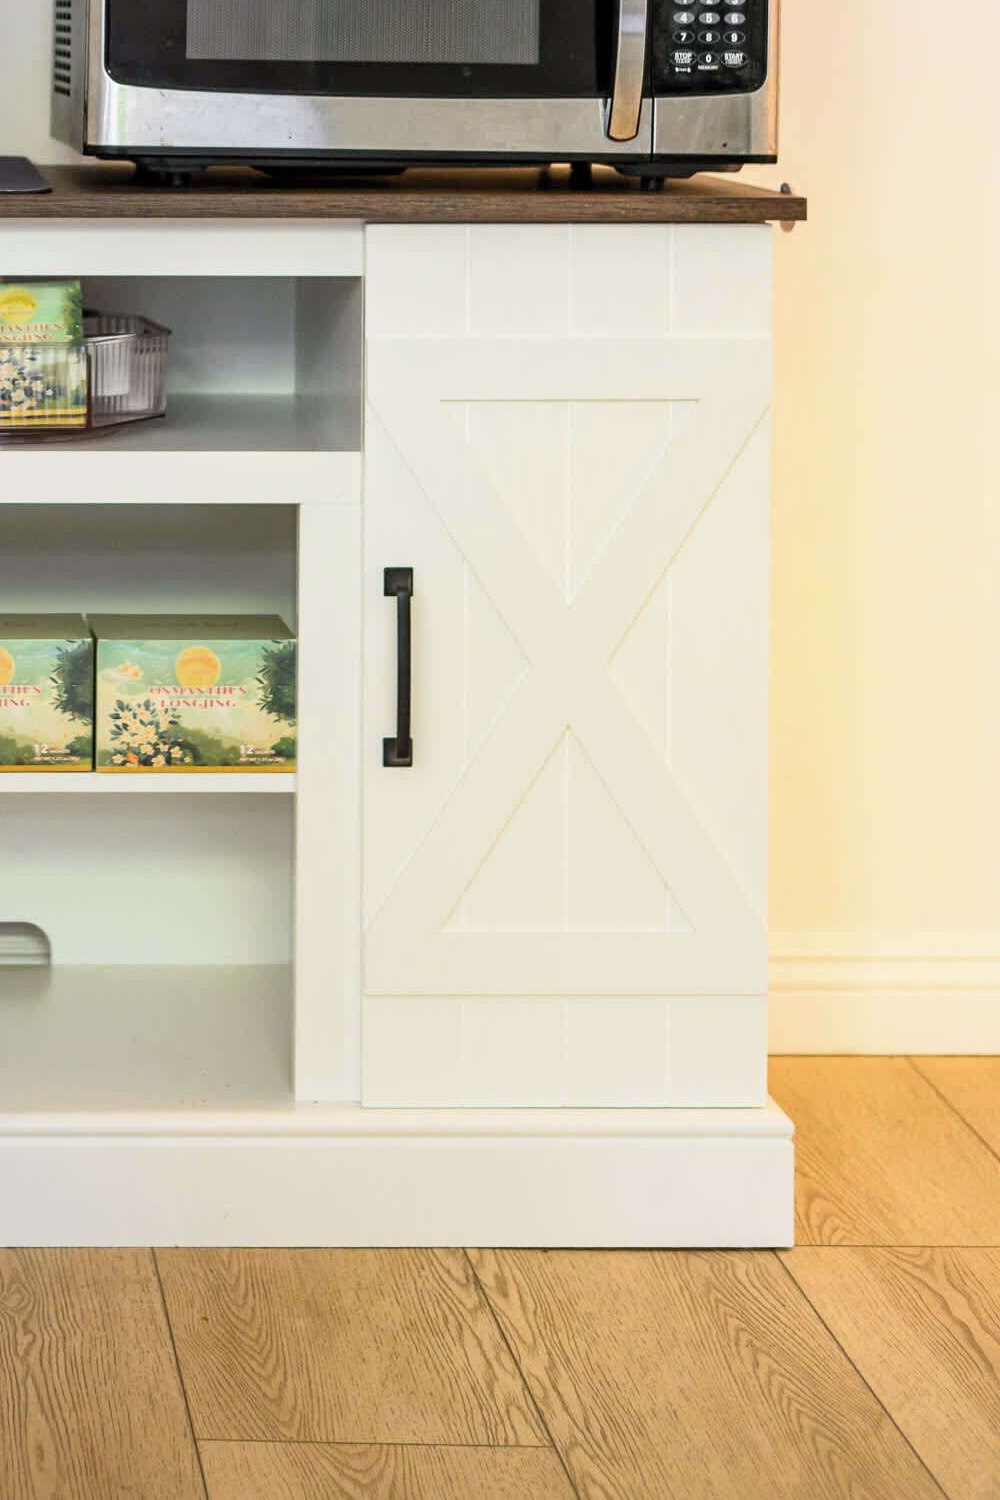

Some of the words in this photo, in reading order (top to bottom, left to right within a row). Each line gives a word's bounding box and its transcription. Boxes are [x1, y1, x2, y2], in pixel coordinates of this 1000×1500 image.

[680, 13, 688, 24] 4
[706, 13, 712, 24] 5
[731, 13, 738, 24] 6
[680, 32, 687, 42] 7
[705, 32, 712, 42] 8
[731, 32, 738, 43] 9
[674, 52, 692, 60] STOP
[705, 54, 712, 63] 0
[724, 52, 744, 60] START
[160, 699, 236, 709] LONGJING
[33, 743, 48, 754] 12
[240, 744, 254, 755] 12
